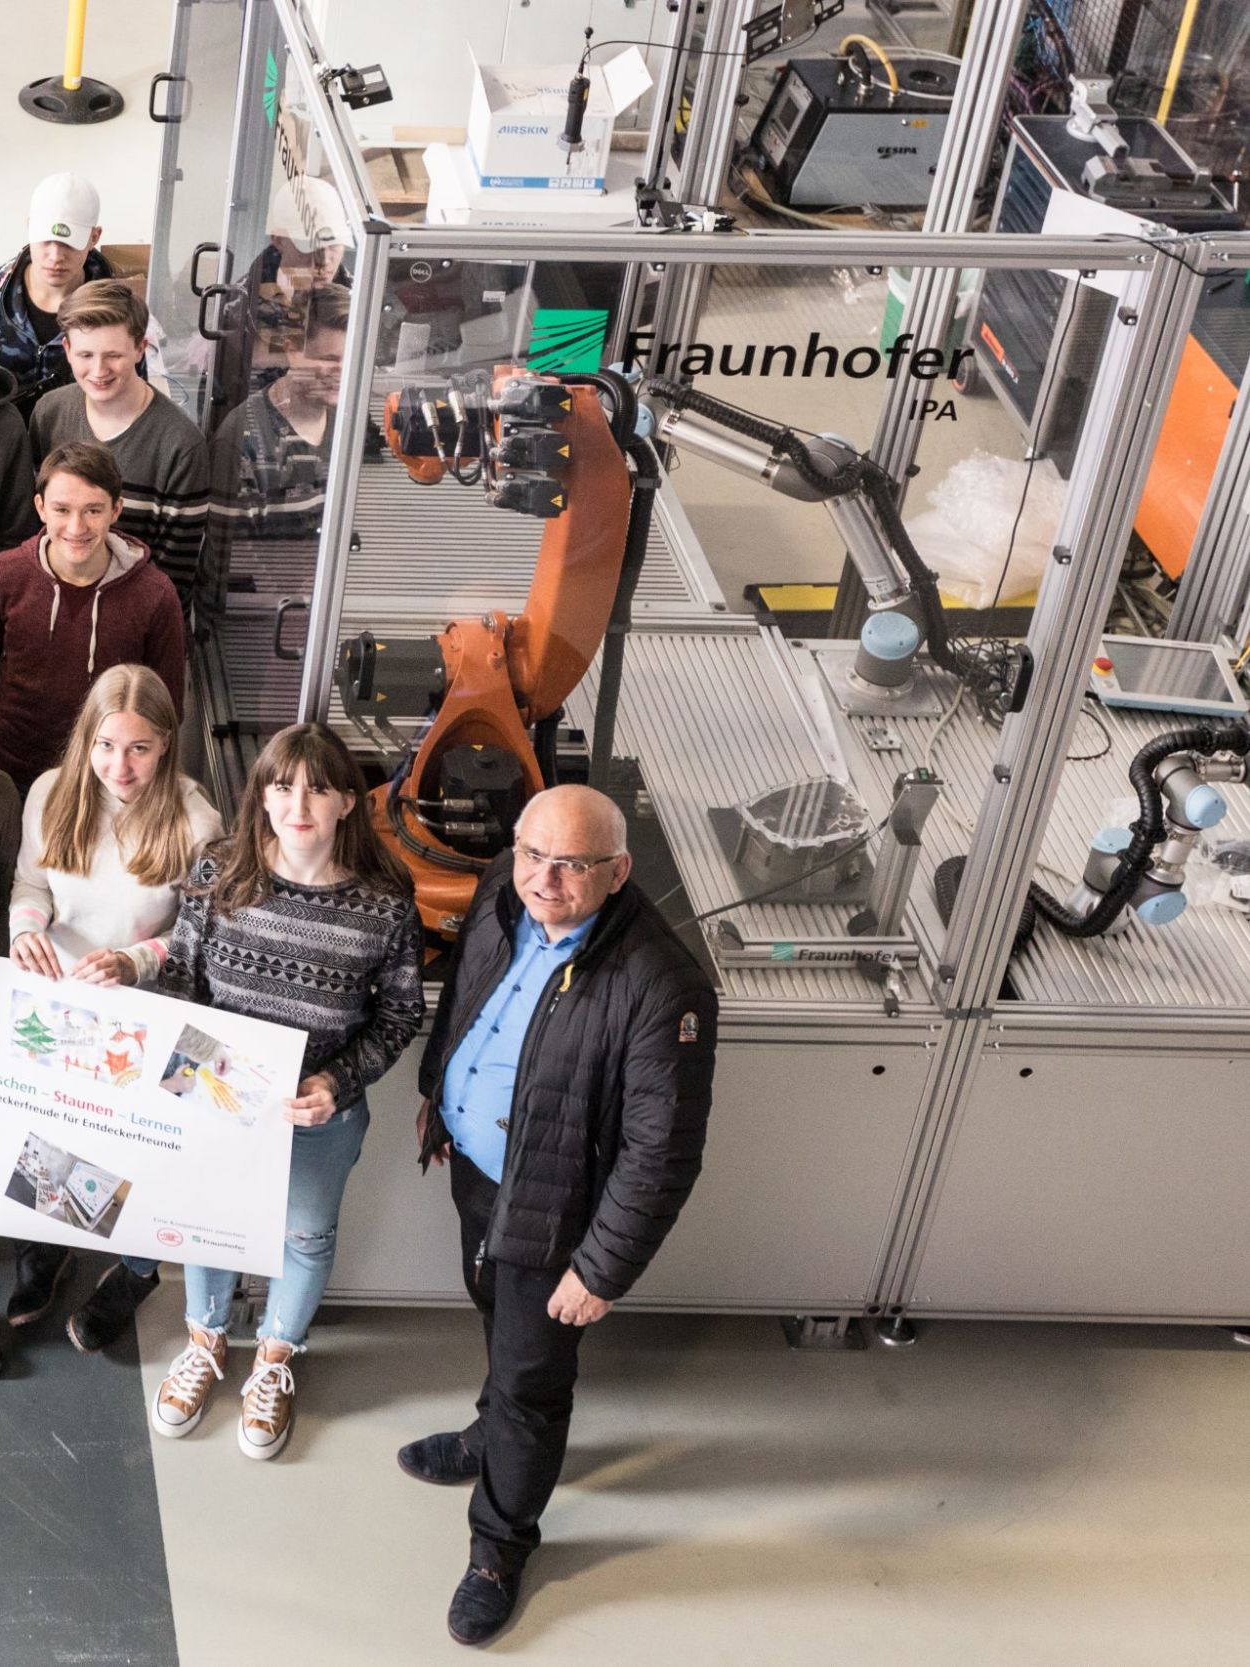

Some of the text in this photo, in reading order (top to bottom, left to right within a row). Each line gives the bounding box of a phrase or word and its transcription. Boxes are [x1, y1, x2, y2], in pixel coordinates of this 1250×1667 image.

[499, 125, 549, 135] AIRSKIN
[622, 332, 975, 380] Fraunhofer
[908, 400, 958, 422] IPA
[798, 948, 900, 963] Fraunhofer
[53, 1090, 114, 1118] Staunen
[131, 1112, 183, 1136] Lernen
[63, 1112, 79, 1125] für
[82, 1118, 182, 1151] Entdeckerfreunde
